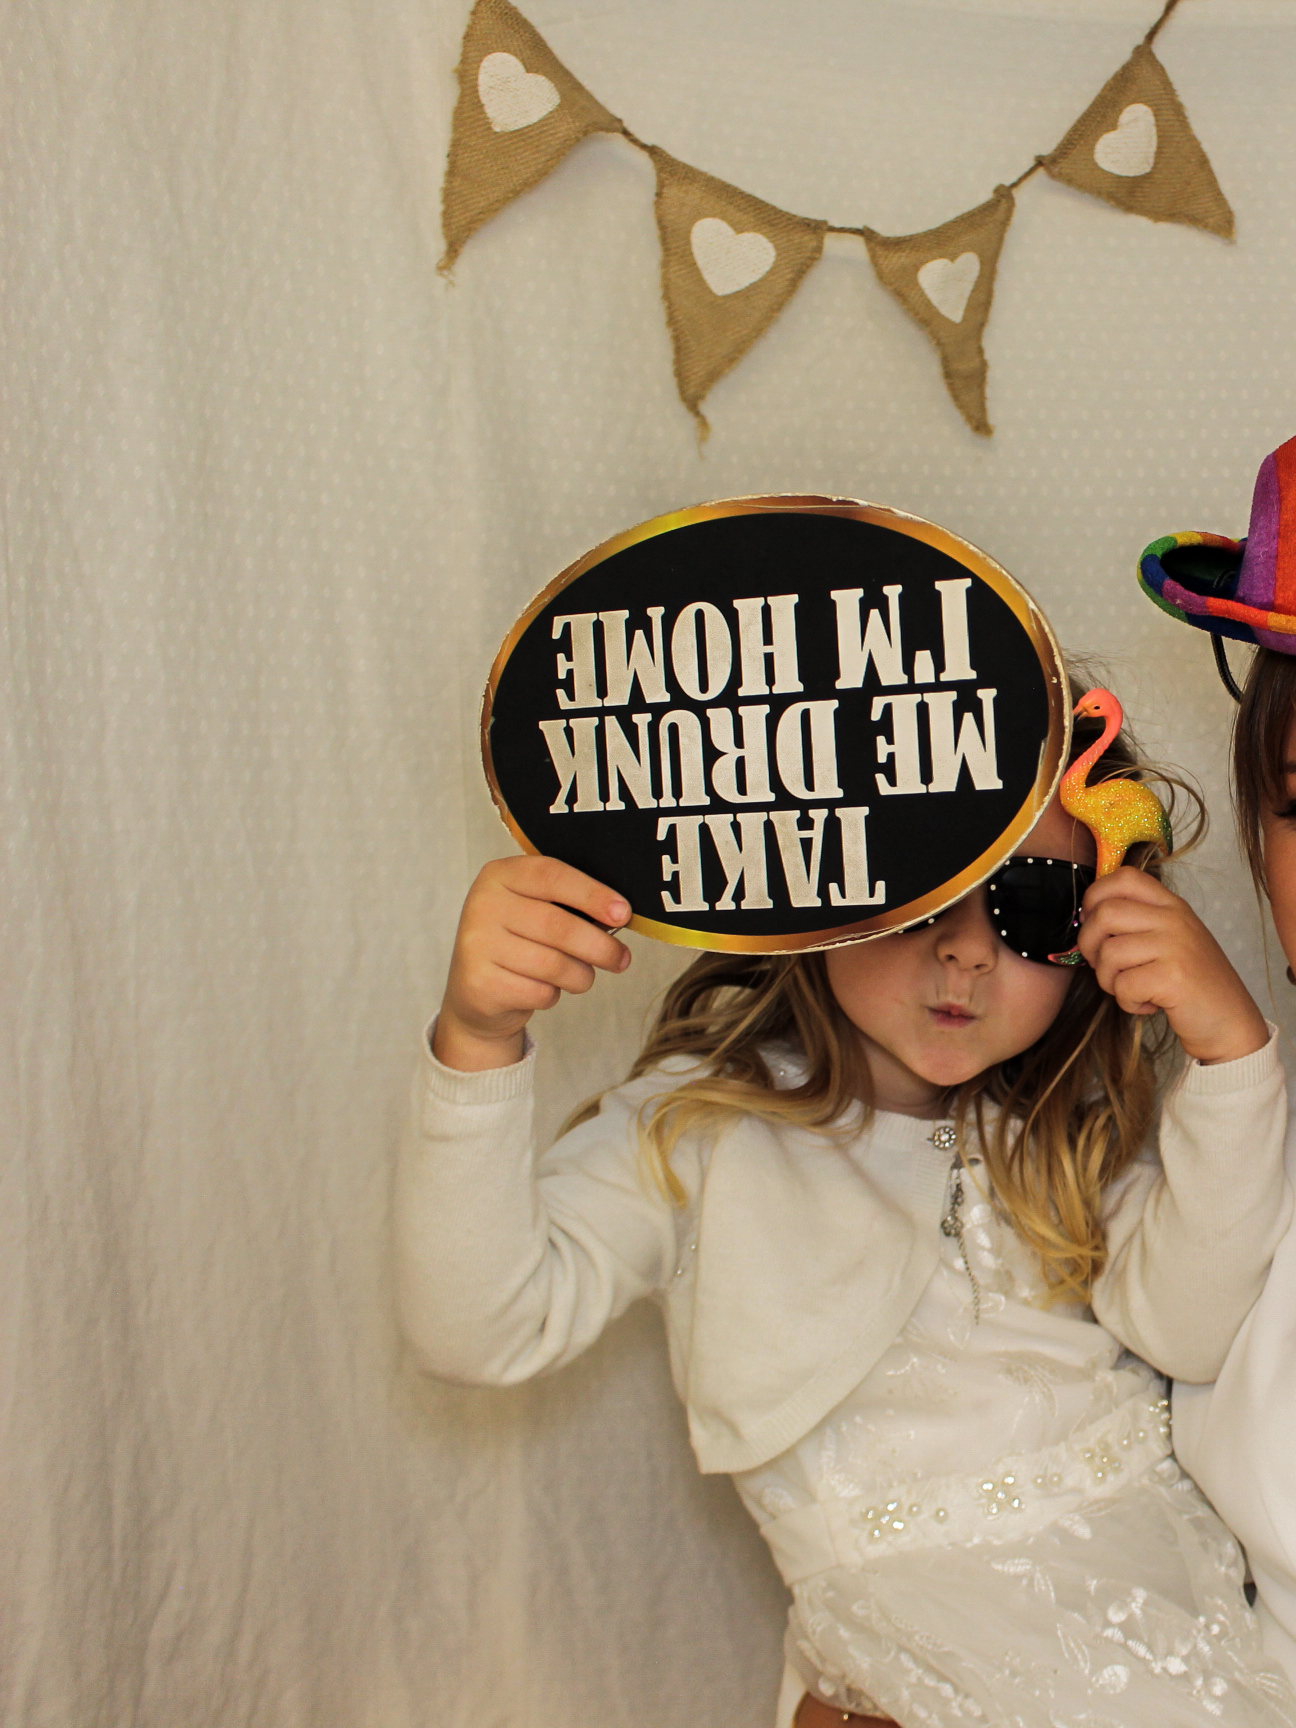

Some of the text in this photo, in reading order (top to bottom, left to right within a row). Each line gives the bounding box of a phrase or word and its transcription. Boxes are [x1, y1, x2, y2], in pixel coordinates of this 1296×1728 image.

[551, 577, 978, 710] I'M HOME
[538, 688, 1003, 814] ME DRUNK
[656, 806, 887, 912] TAKE
